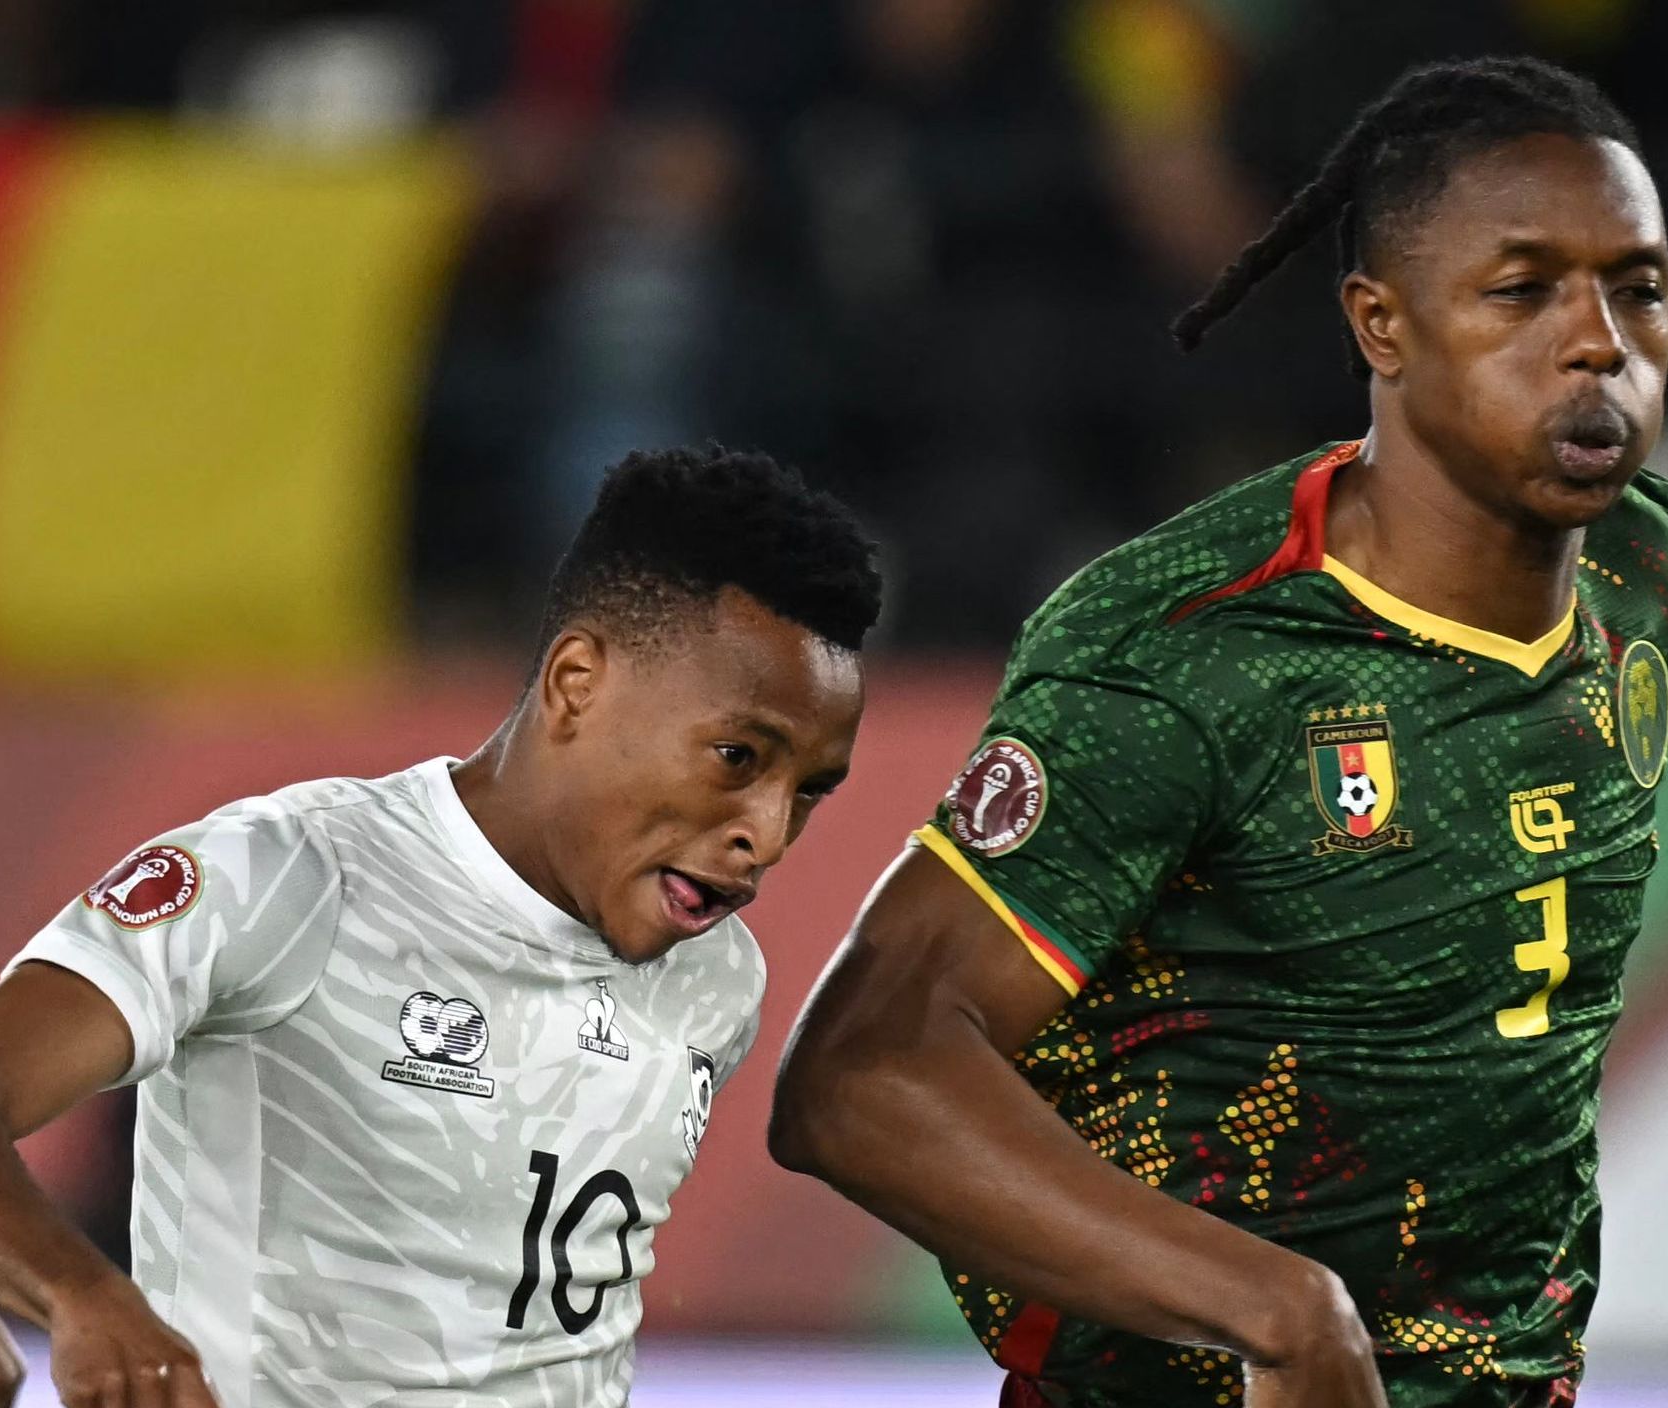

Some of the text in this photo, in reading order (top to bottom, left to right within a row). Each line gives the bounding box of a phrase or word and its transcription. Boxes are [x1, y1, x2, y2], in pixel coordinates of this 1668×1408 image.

[1313, 726, 1384, 743] CAMEROUN
[1508, 781, 1577, 803] FOURTEEN
[172, 853, 195, 885] AFRICA
[159, 901, 176, 915] OF
[175, 886, 192, 907] CUP
[106, 901, 160, 925] NATIONS
[1495, 875, 1571, 1039] 3
[386, 1067, 490, 1093] FOOTBALL ASSOCIATION
[407, 1061, 476, 1080] SOUTH AFRICAN
[506, 1149, 641, 1336] 10
